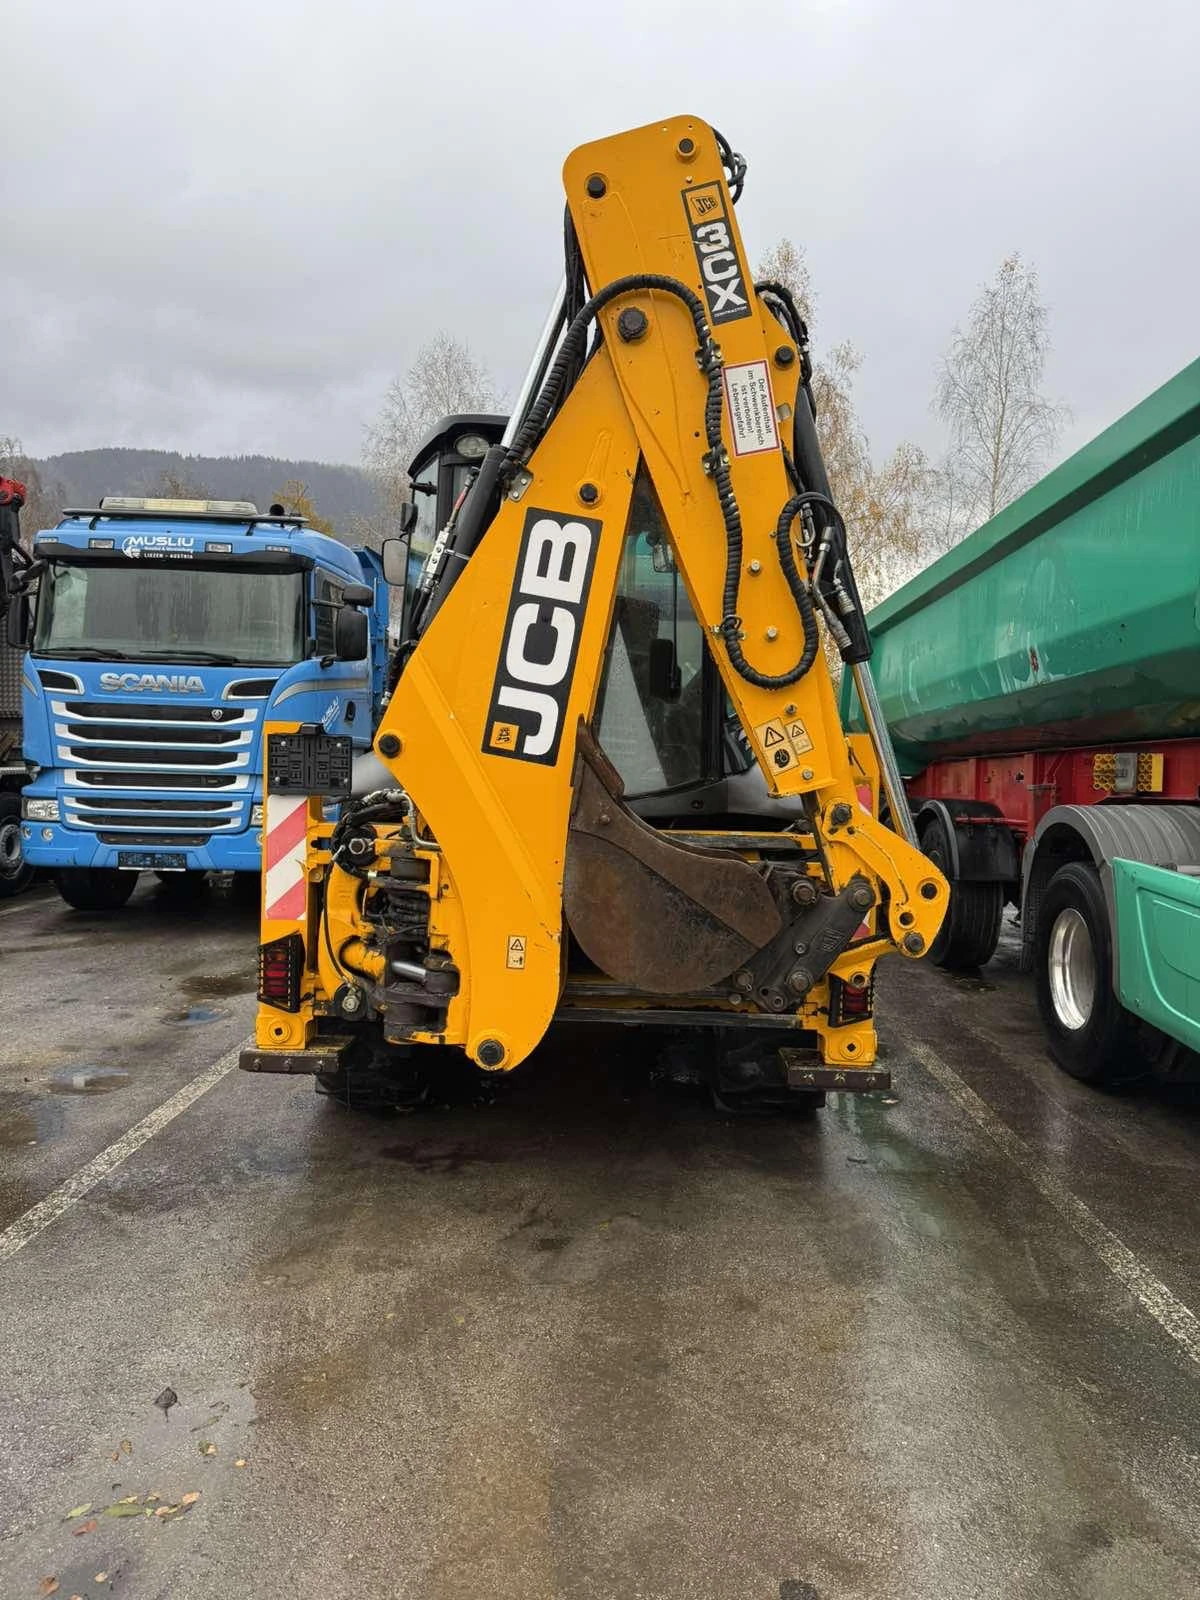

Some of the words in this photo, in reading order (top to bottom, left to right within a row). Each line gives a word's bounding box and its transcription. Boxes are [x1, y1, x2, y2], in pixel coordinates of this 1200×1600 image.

[696, 222, 748, 313] 3CX
[747, 370, 754, 380] im
[731, 382, 746, 439] Lebensgefahr!
[743, 396, 754, 433] verboten!
[749, 381, 765, 445] Schwenkbereich
[760, 394, 772, 434] Aufenthalt
[128, 535, 194, 547] MUSLIU
[498, 519, 592, 756] JCB
[100, 672, 206, 693] SCANIA
